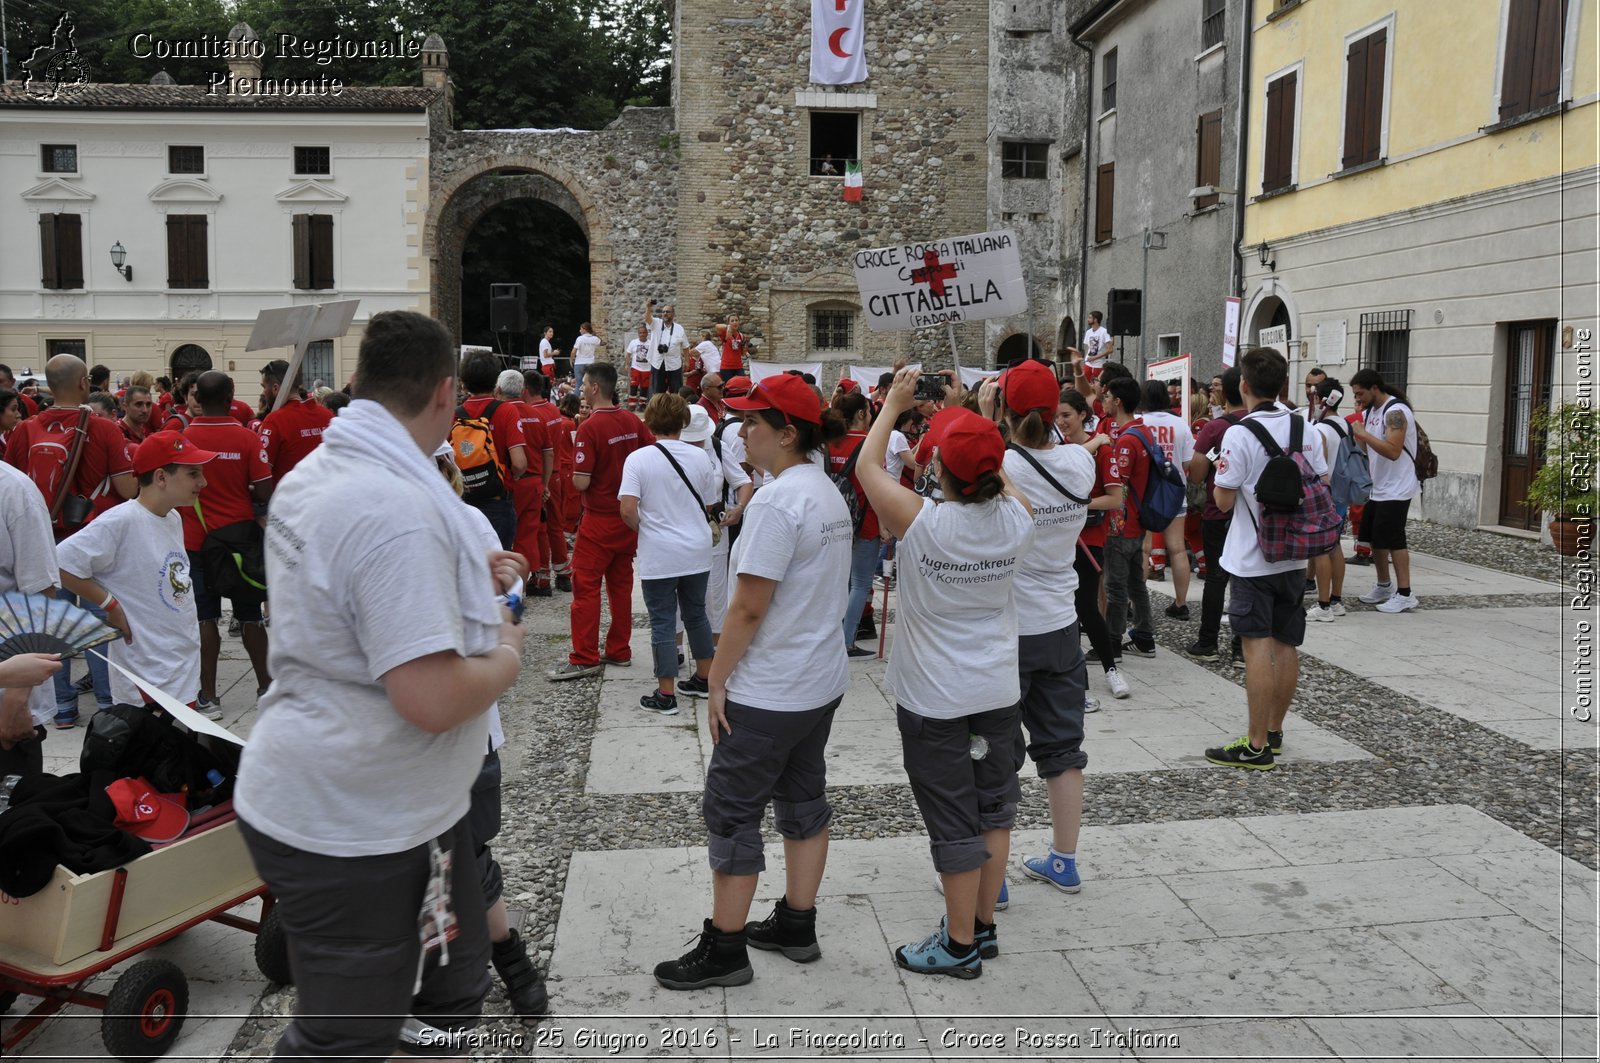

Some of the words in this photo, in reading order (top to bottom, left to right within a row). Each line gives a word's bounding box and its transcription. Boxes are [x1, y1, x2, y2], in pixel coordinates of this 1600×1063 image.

[854, 247, 901, 269] CROCE
[904, 242, 950, 263] ROSSA
[953, 234, 1012, 257] ITALIANA
[868, 278, 1003, 318] CITTADELLA
[909, 307, 967, 328] (PADOVA)
[919, 553, 1017, 572] Jugendrotkreuz
[936, 569, 1015, 585] Kornwestheim
